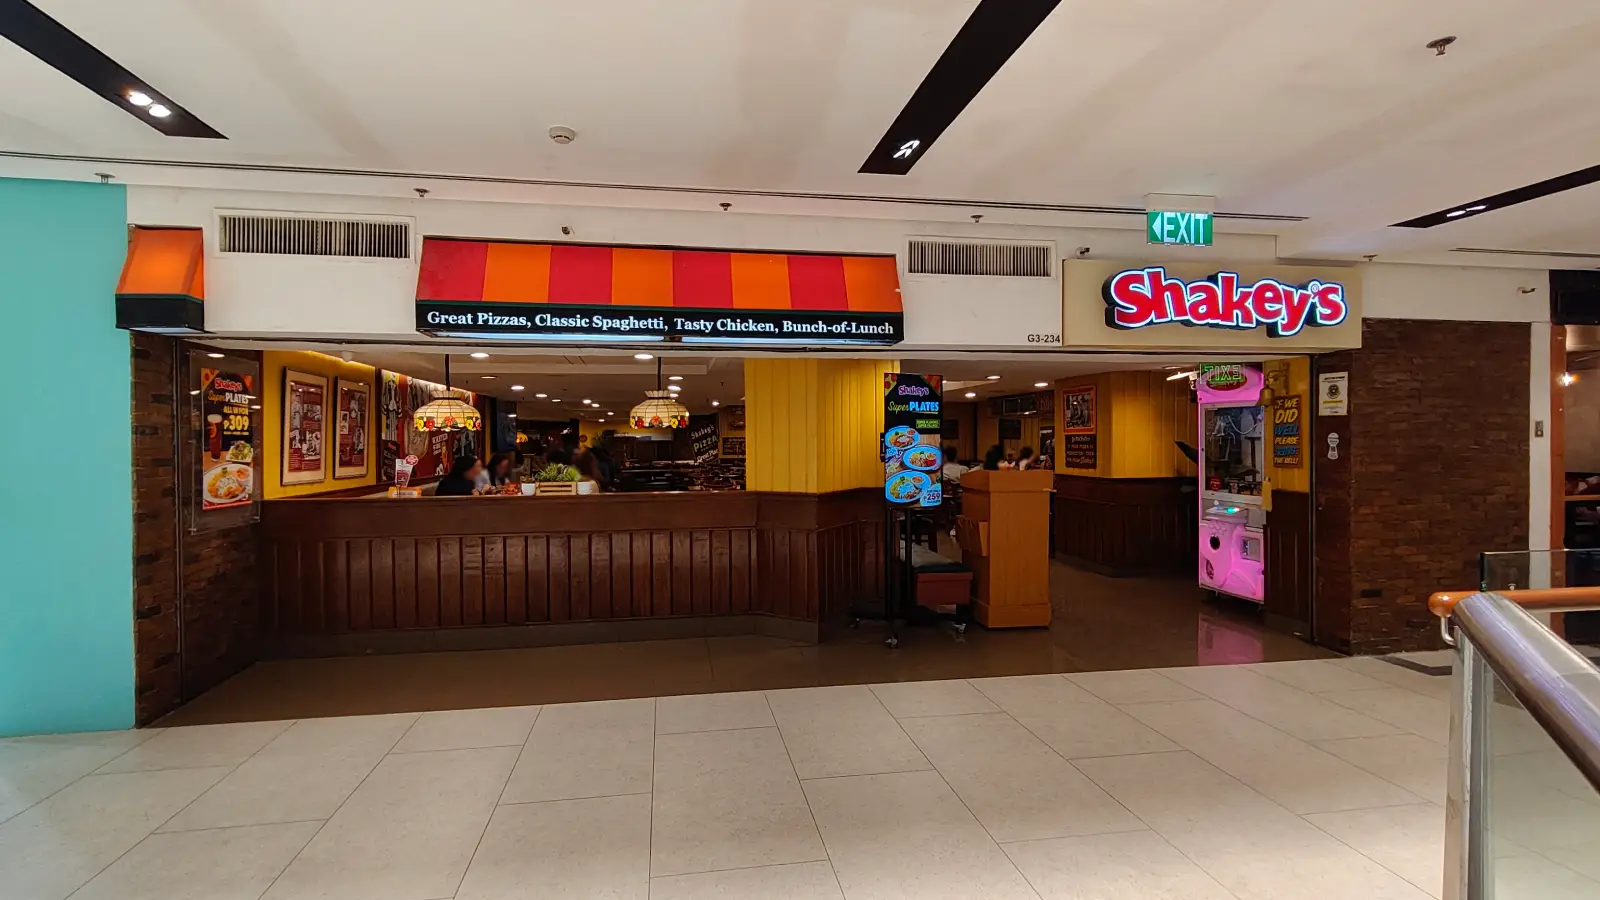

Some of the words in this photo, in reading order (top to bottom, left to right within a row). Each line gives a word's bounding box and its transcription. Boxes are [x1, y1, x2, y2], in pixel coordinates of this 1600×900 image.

[1162, 212, 1208, 244] EXIT
[1109, 266, 1348, 337] Shakey's
[427, 311, 474, 325] Great
[476, 312, 532, 329] Pizzas,
[534, 313, 590, 328] Classic
[592, 315, 668, 331] Spaghetti,
[674, 317, 714, 332] Tasty
[716, 318, 779, 334] Chicken,
[782, 320, 894, 335] Bunch-of-Lunch
[1027, 333, 1061, 343] G3-234
[898, 384, 930, 397] Shakey's
[225, 391, 249, 404] PLATES
[1284, 397, 1299, 408] WE
[223, 405, 232, 414] ALL
[887, 400, 909, 415] Super
[909, 401, 940, 412] PLATES
[1274, 408, 1299, 424] DID
[1274, 437, 1299, 445] PLEASE
